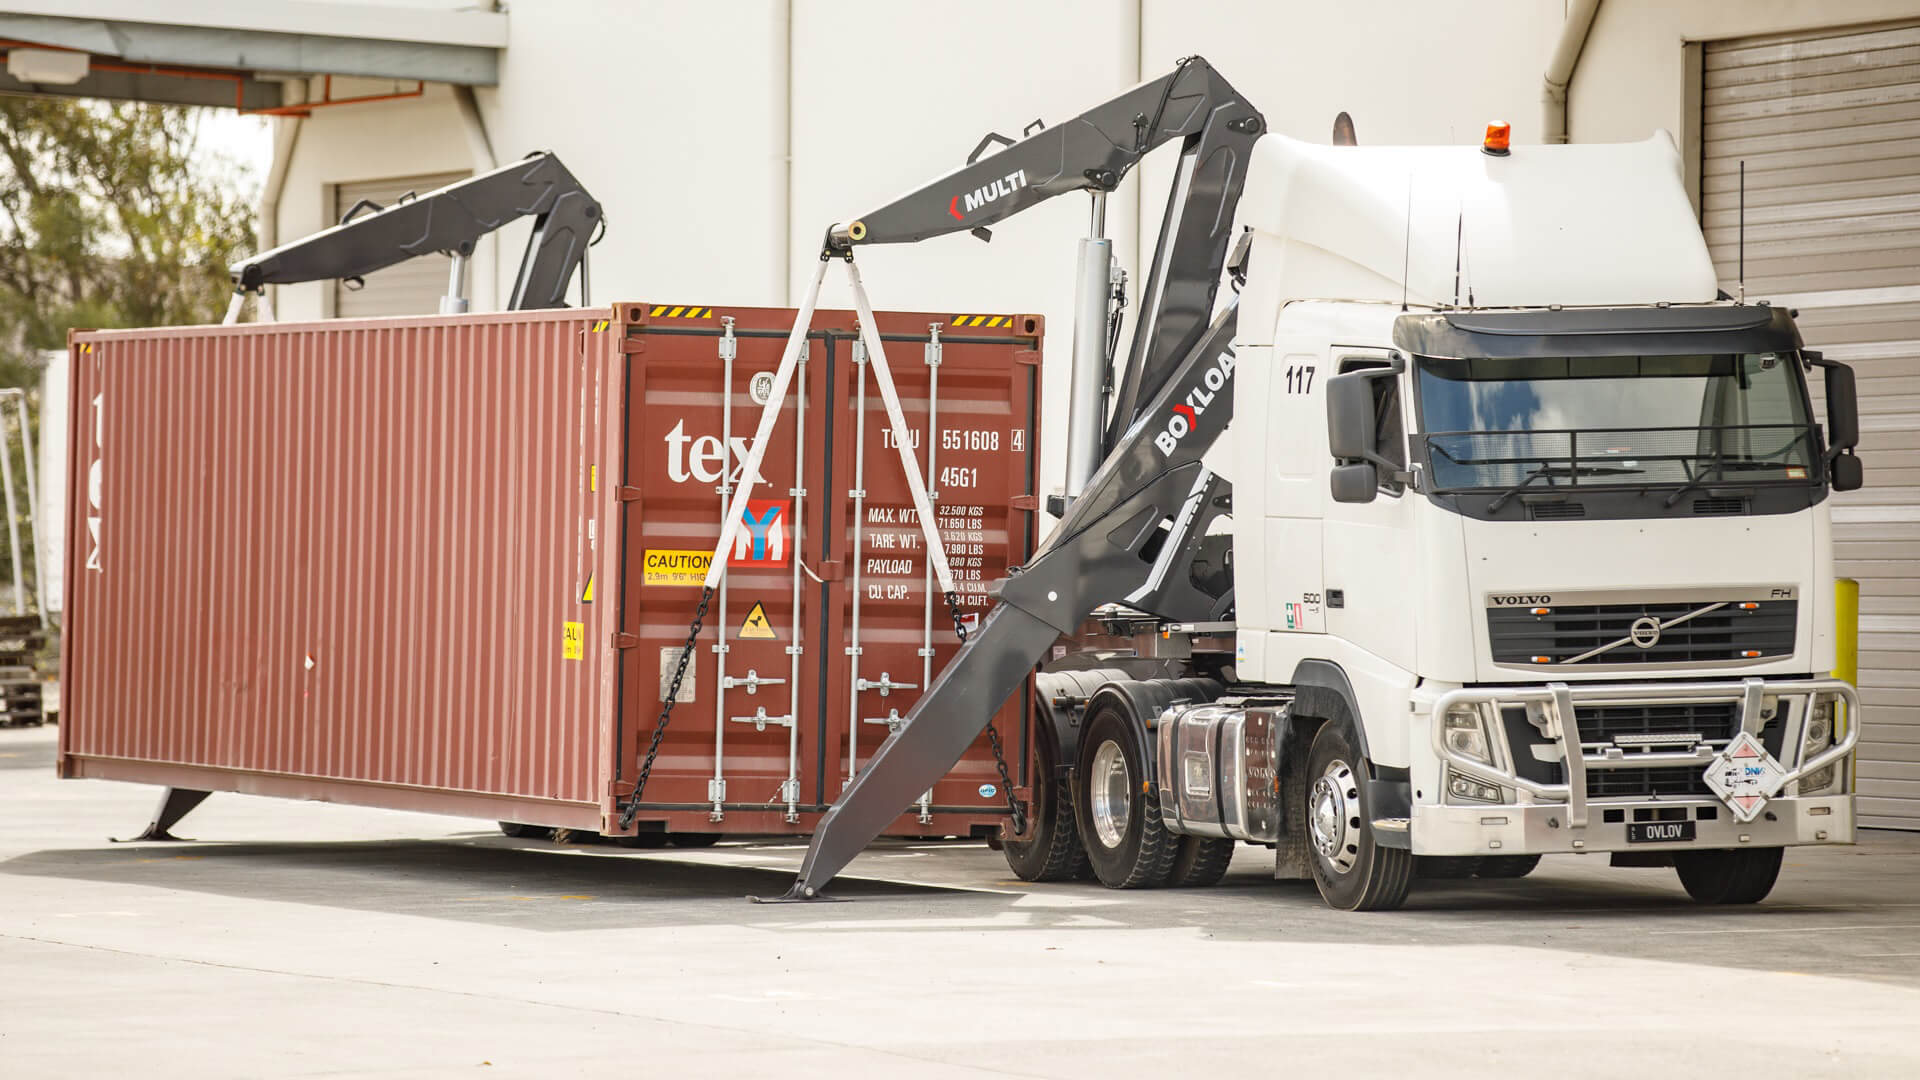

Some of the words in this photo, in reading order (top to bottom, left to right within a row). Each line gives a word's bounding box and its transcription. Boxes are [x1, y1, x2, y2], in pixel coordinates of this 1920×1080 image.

[964, 169, 1027, 212] MULTI
[1286, 365, 1316, 394] 117
[881, 428, 920, 449] TCU
[942, 429, 1000, 451] 551608
[1012, 430, 1023, 450] 4
[940, 467, 977, 488] 45G1
[868, 508, 896, 523] MAX.
[899, 508, 919, 523] WT.
[968, 506, 984, 516] KGS
[967, 518, 982, 529] LBS
[870, 533, 896, 549] TARE
[899, 534, 920, 549] WT.
[968, 544, 984, 555] LBS
[647, 554, 713, 569] CAUTION
[867, 559, 913, 574] PAYLOAD
[967, 557, 982, 567] KGS
[690, 573, 705, 582] HIG
[966, 570, 981, 580] LBS
[868, 585, 884, 600] CU.
[887, 585, 910, 600] CAP.
[1303, 593, 1321, 604] 500
[1492, 595, 1552, 605] VOLVO
[1771, 588, 1792, 598] FH
[1646, 824, 1682, 839] OVLOV
